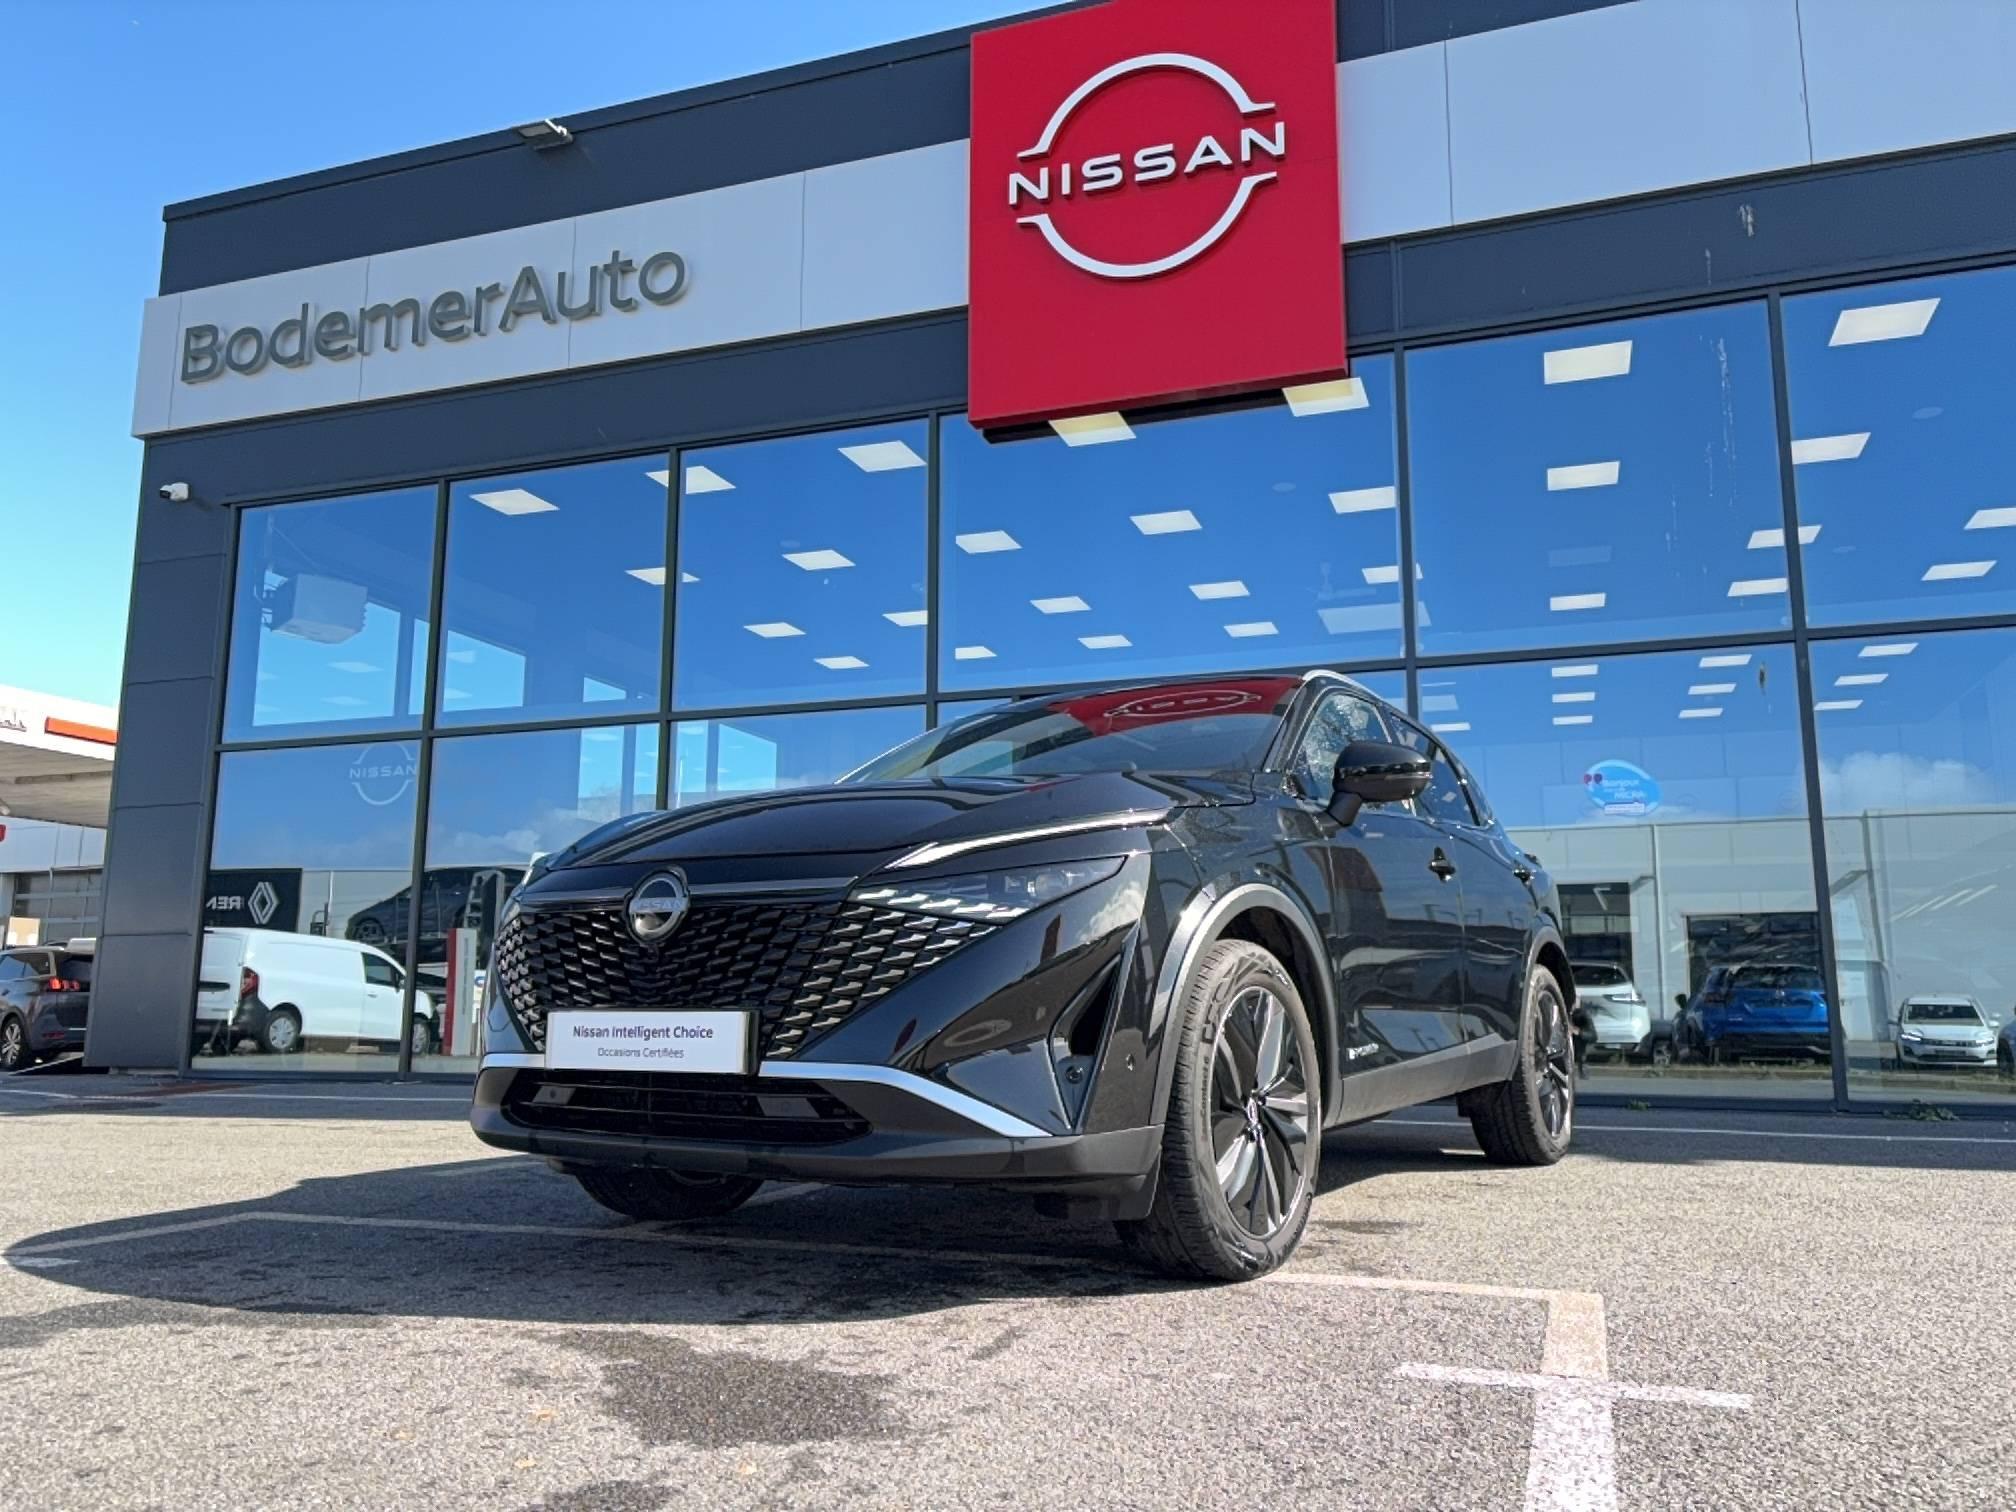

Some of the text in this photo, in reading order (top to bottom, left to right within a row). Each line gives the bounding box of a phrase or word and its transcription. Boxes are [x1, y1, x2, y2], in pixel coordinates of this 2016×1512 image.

[1009, 122, 1285, 205] NISSAN
[180, 249, 686, 383] BodemerAuto
[350, 765, 417, 779] NISSAN
[573, 1026, 714, 1041] Nissan Intelligent Choice
[597, 1047, 685, 1059] Occasions Certifiées
